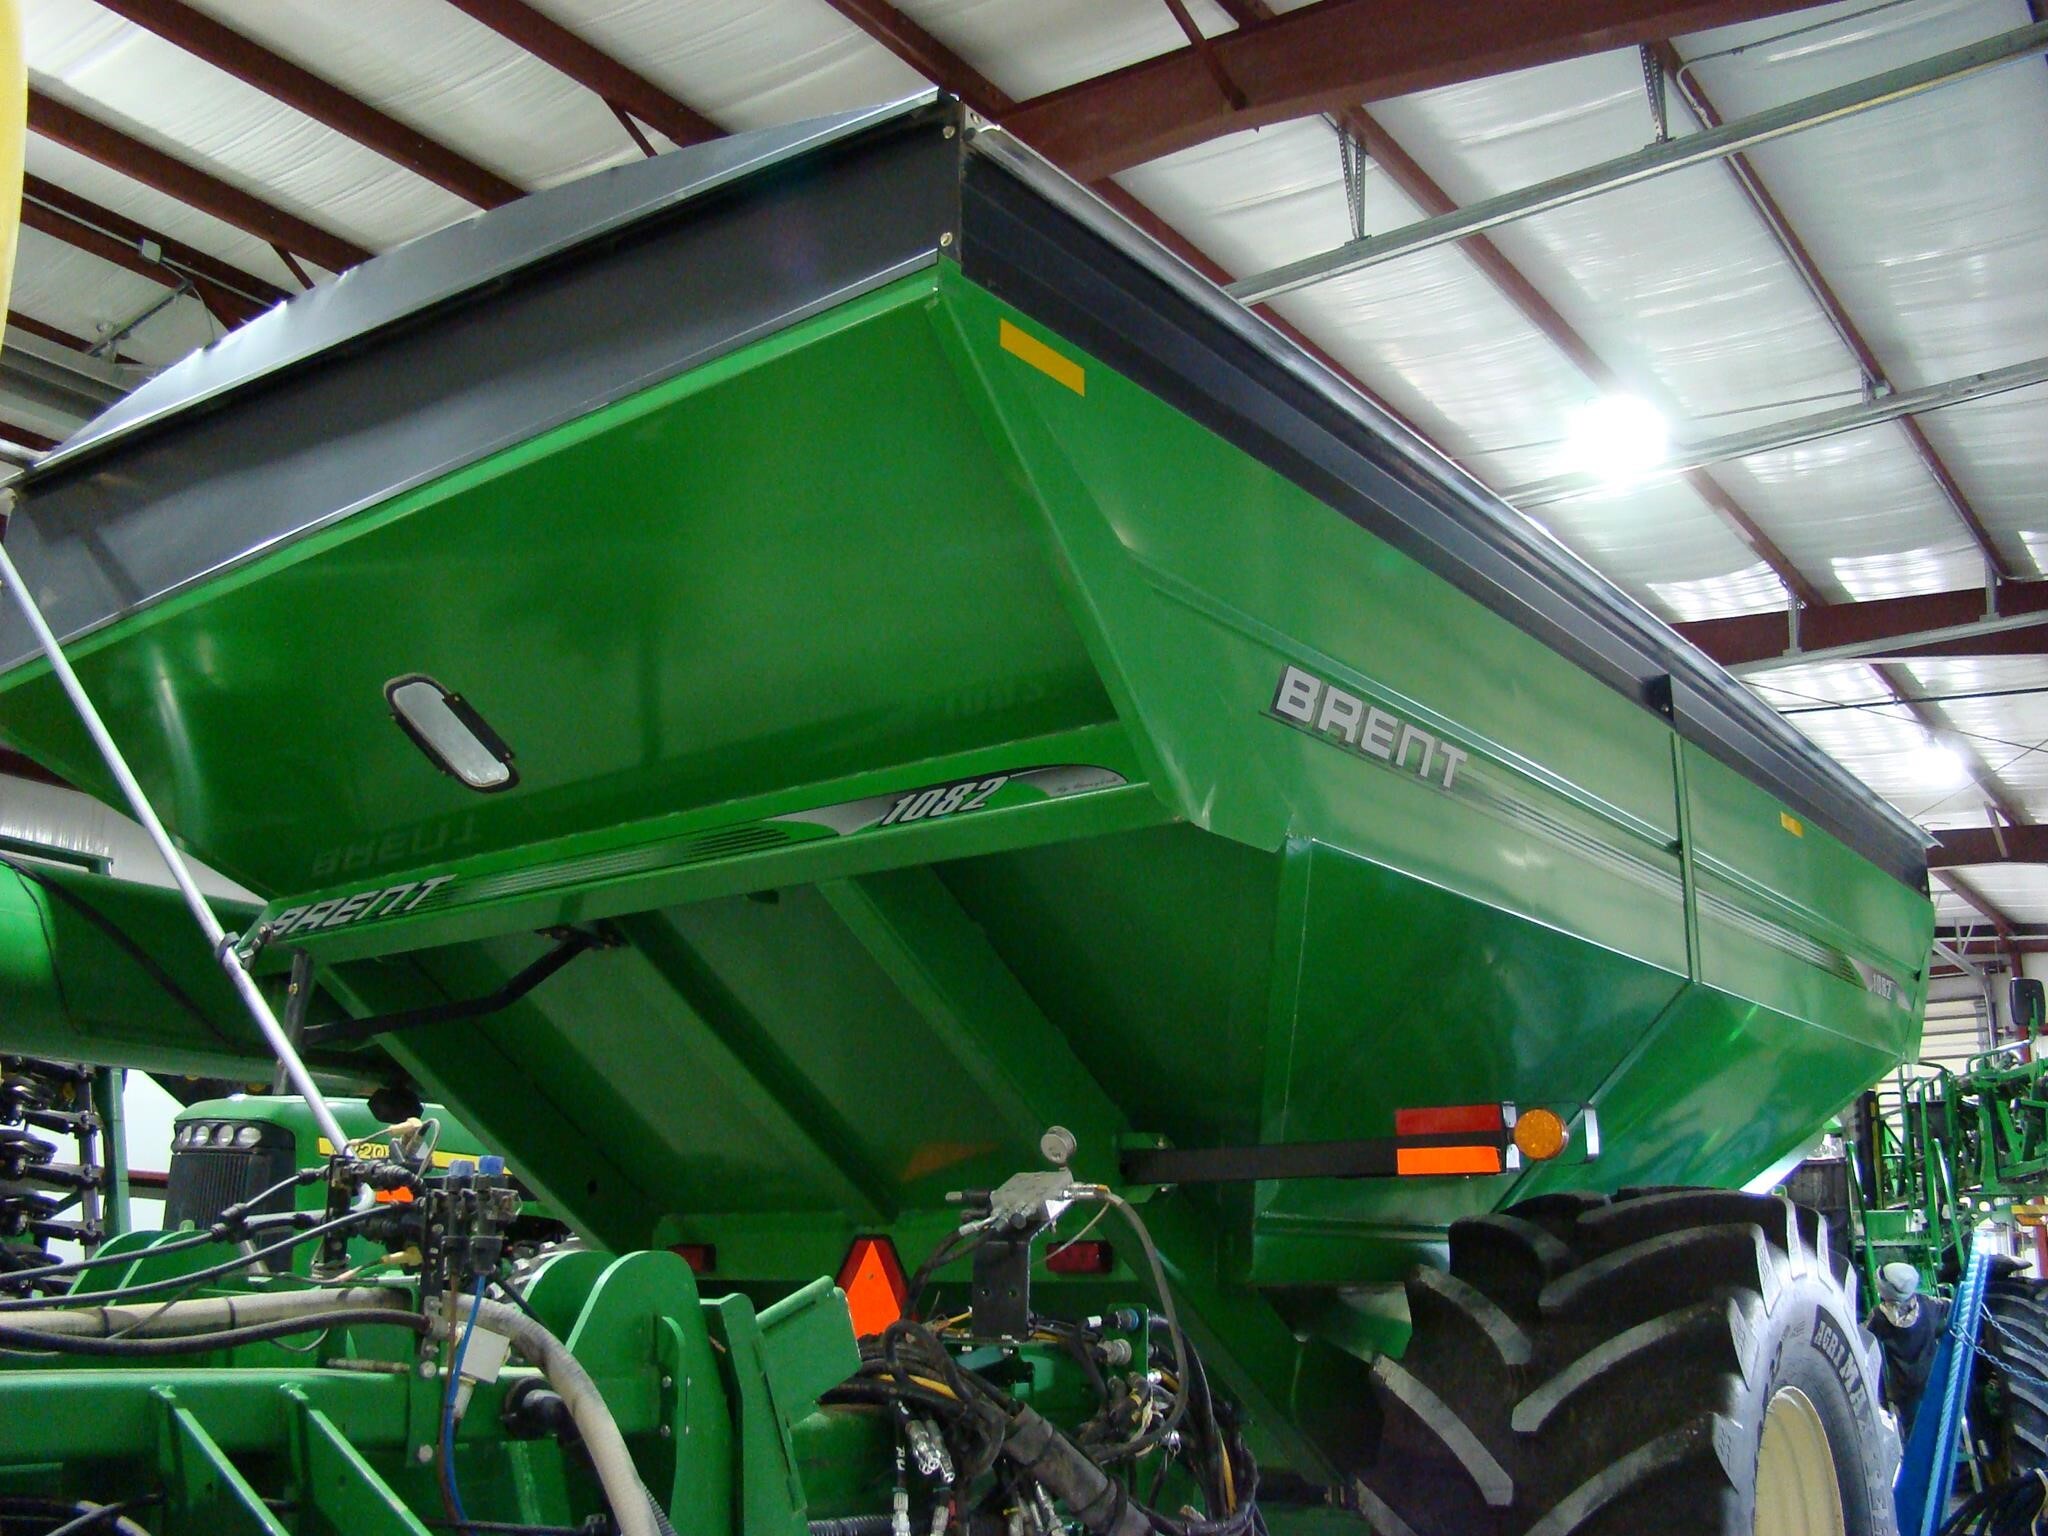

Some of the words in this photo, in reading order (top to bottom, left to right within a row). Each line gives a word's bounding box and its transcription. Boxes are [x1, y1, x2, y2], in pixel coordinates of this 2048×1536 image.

[1272, 665, 1467, 789] BRENT
[877, 775, 1009, 828] 1082
[268, 873, 458, 936] BRENT
